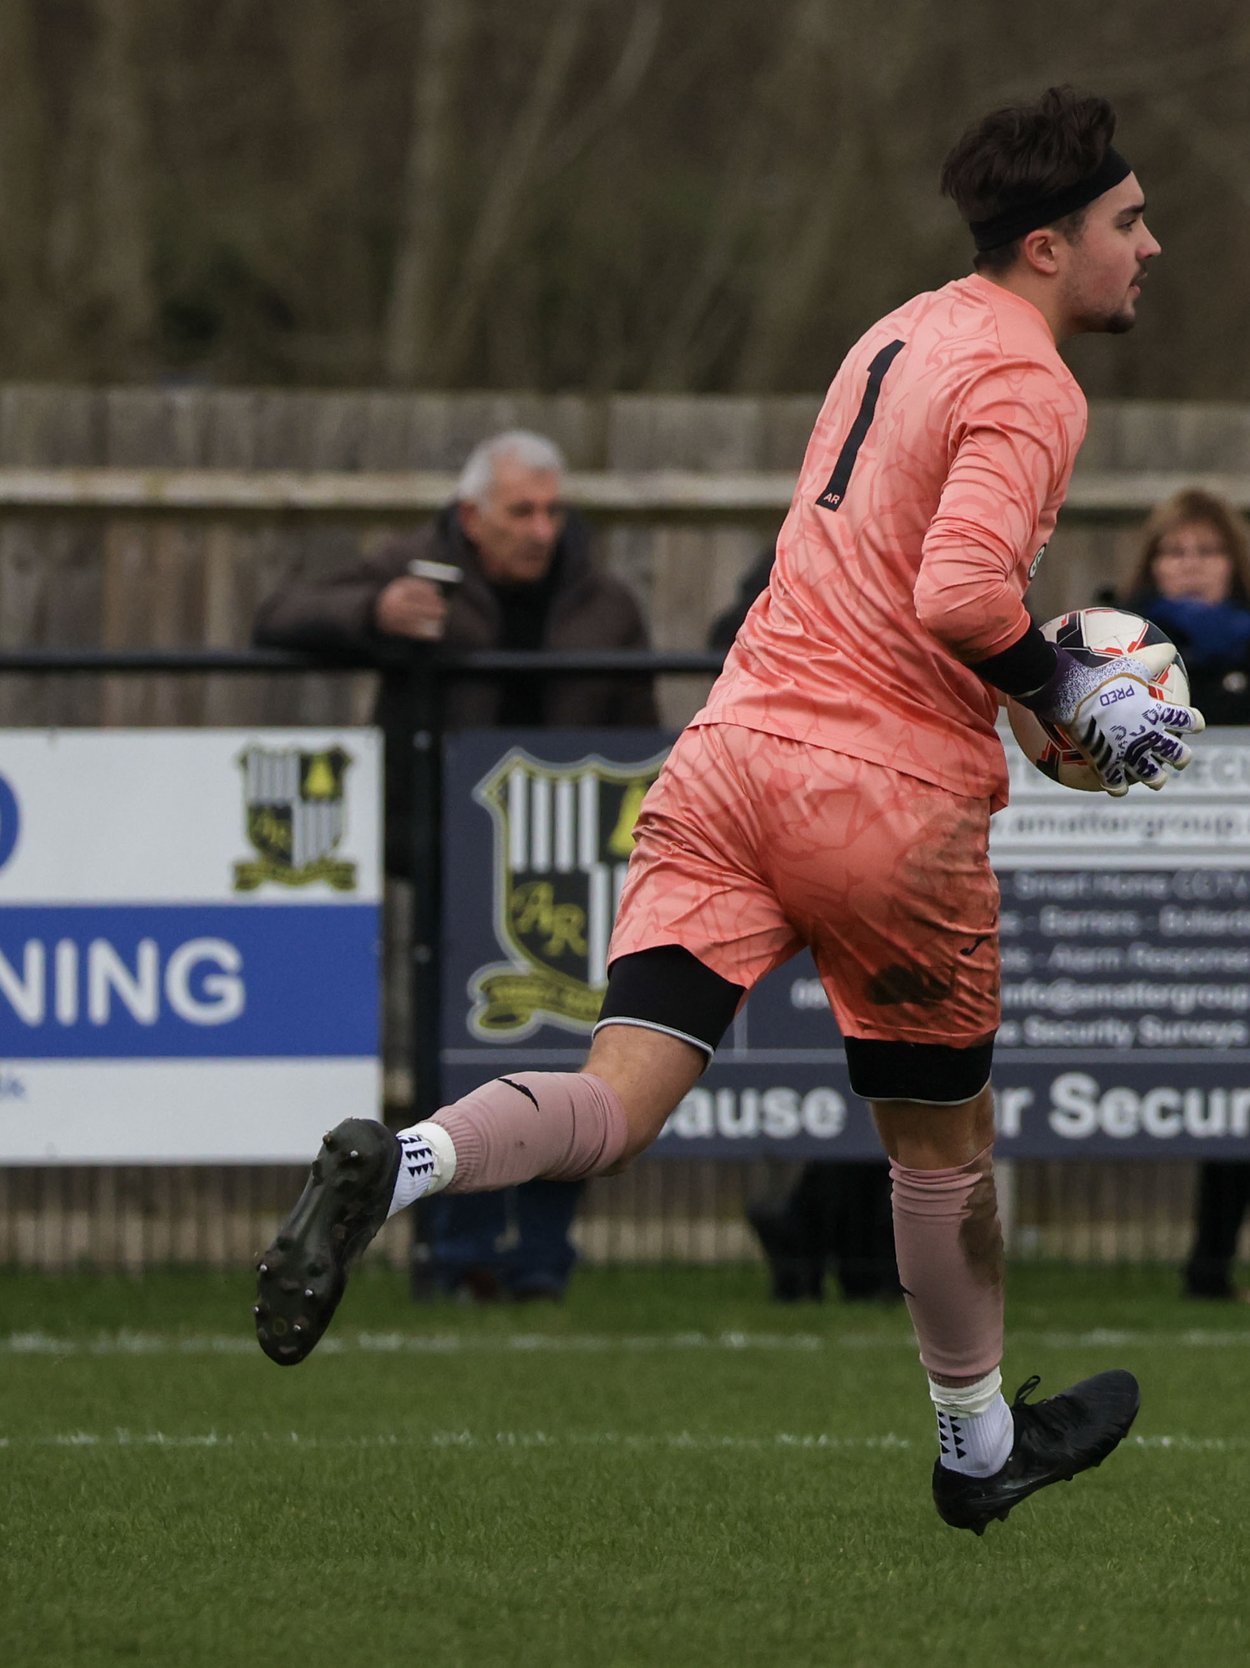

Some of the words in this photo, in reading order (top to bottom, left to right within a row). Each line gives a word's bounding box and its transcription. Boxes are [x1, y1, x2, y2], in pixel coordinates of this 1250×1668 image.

[815, 339, 906, 512] 1
[823, 492, 841, 505] AR
[1099, 685, 1135, 707] PRED
[1094, 872, 1169, 899] Home
[1172, 871, 1250, 899] CCTV
[1040, 904, 1141, 936] Barriers
[1048, 943, 1122, 973] Alarm
[1024, 1015, 1134, 1049] Security
[1138, 1015, 1250, 1049] Surveys
